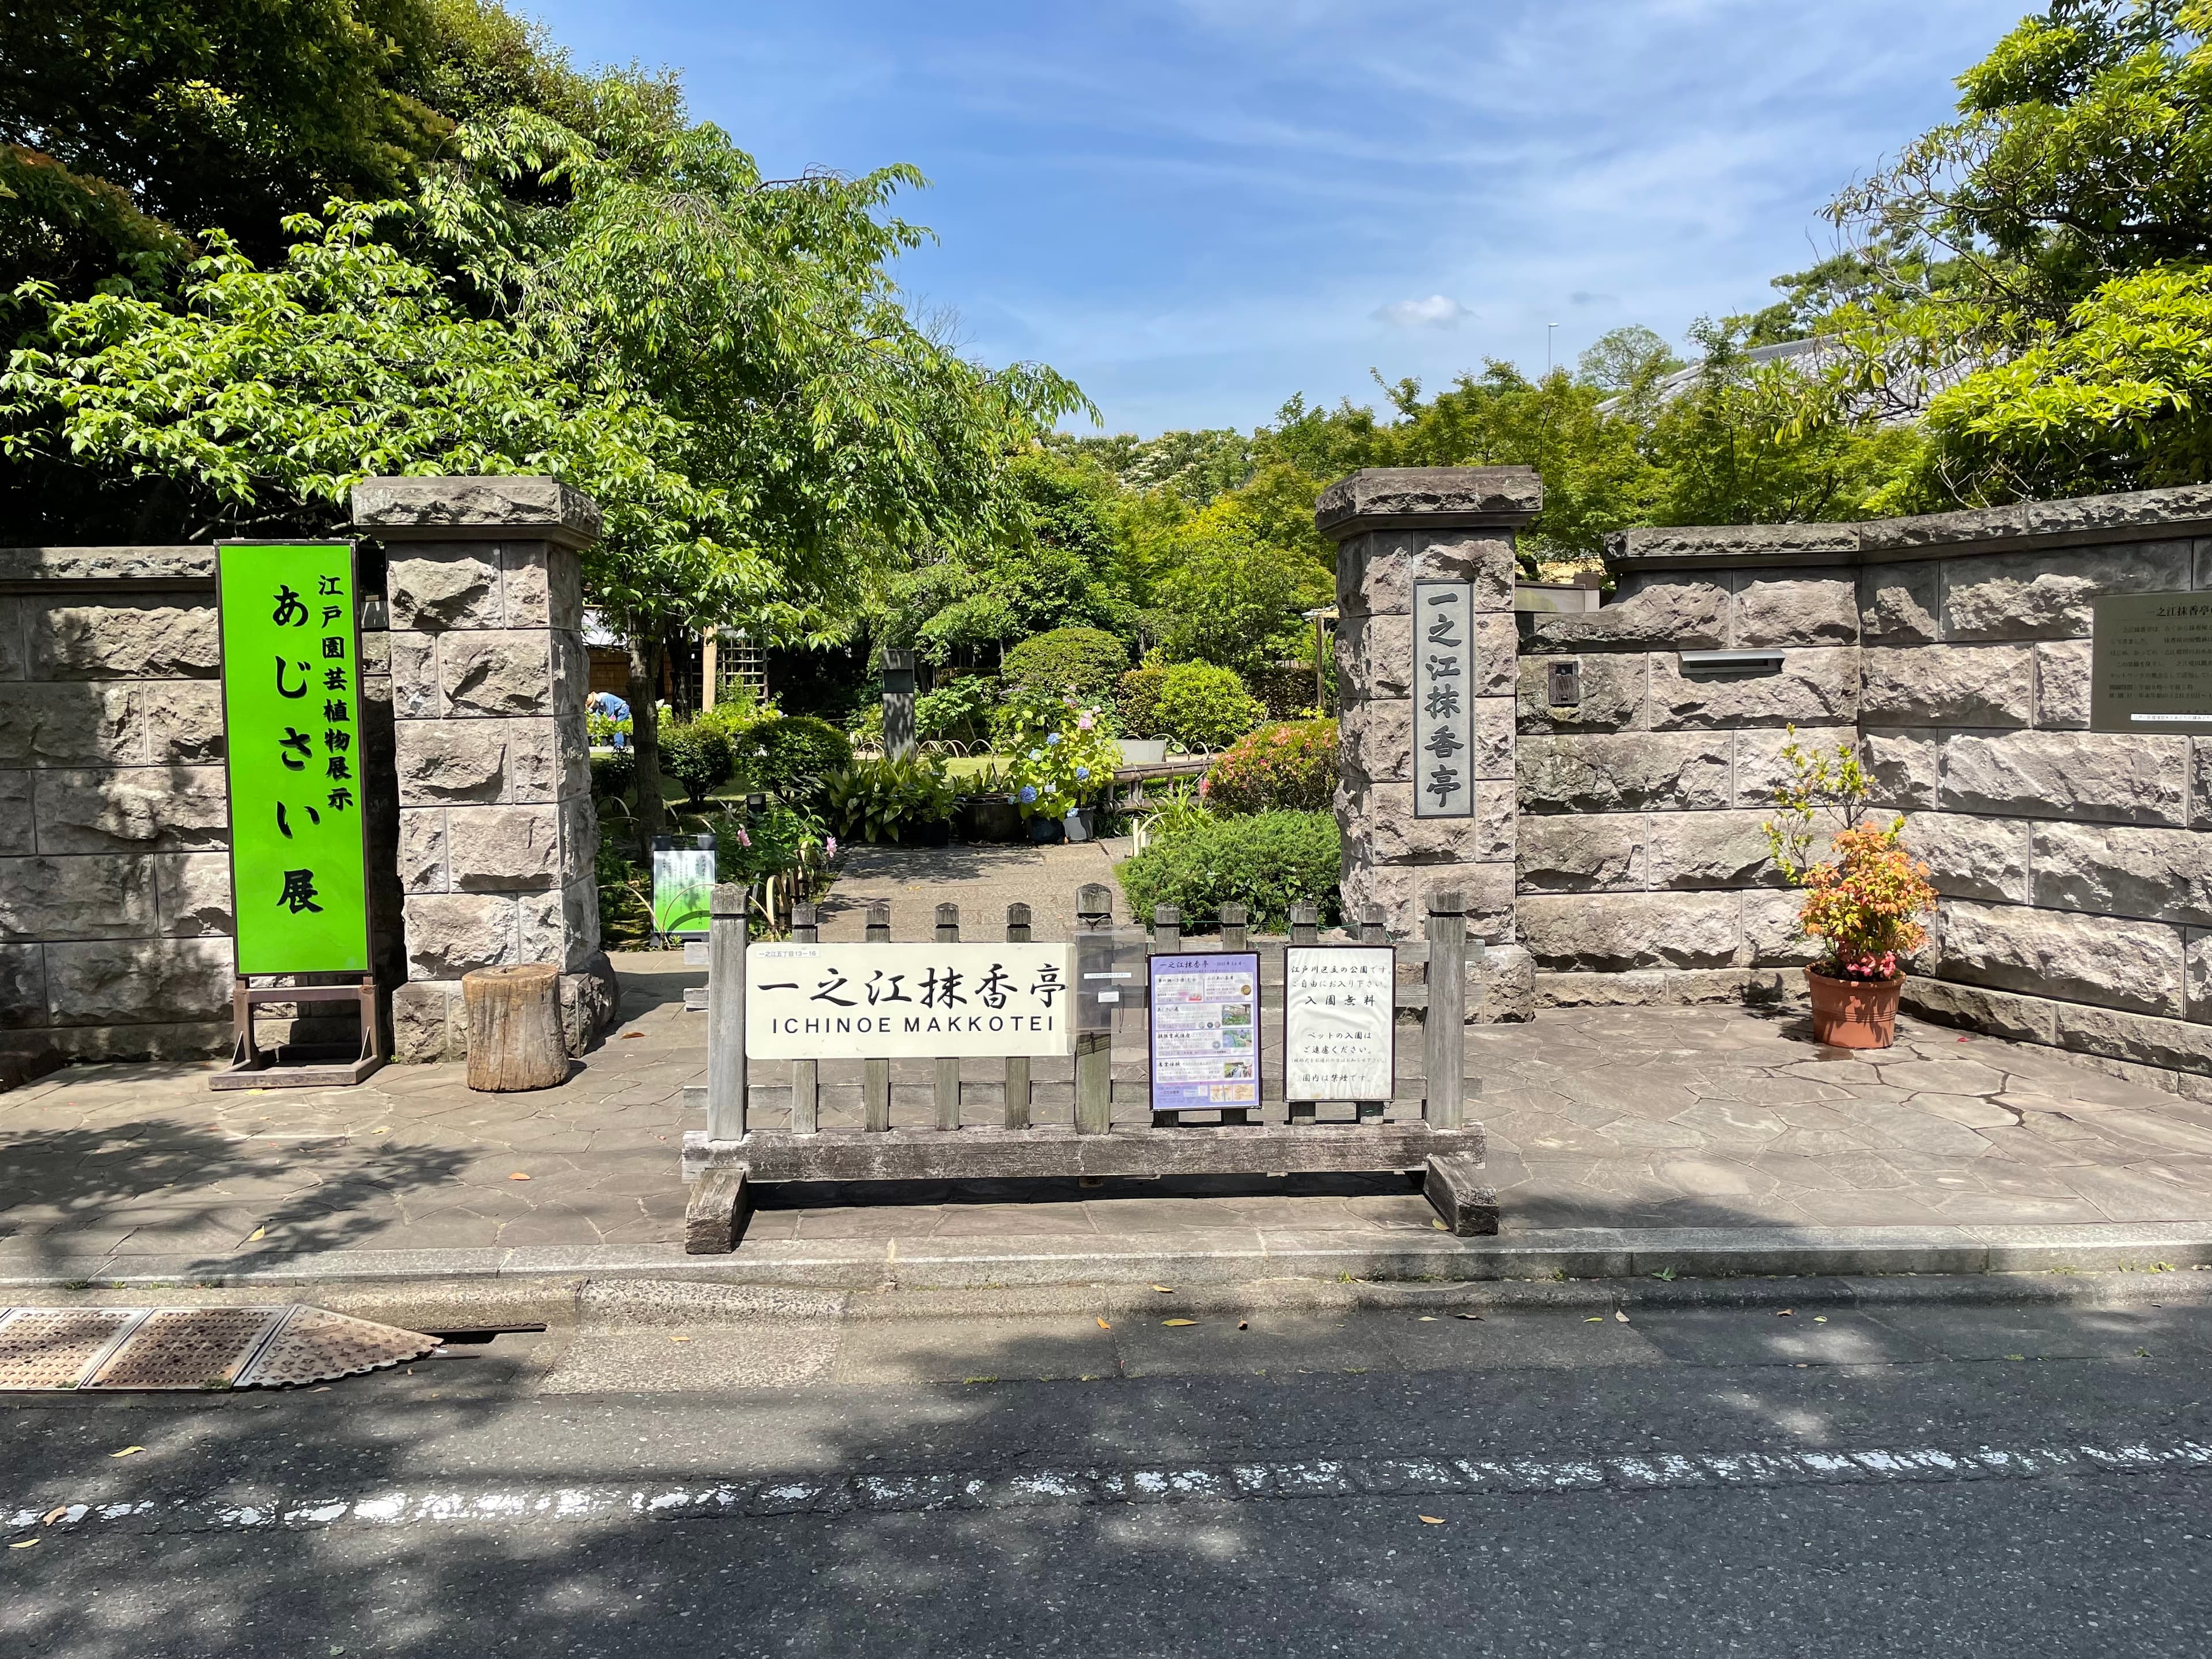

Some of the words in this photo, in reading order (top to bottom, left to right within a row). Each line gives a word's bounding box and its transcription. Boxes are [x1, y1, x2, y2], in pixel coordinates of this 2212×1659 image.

[2146, 604, 2212, 617] 一之江抹香亭
[318, 574, 354, 812] 江戸園芸植物展示
[1424, 592, 1464, 808] 一之江抹香亭
[272, 584, 324, 915] あじさい展
[756, 962, 1069, 1010] 一之江抹香亭
[1305, 994, 1376, 1006] 入園無料
[772, 1017, 891, 1034] ICHINOE
[904, 1016, 1053, 1032] MAKKOTEI
[1308, 1031, 1372, 1039] ペットの入園は
